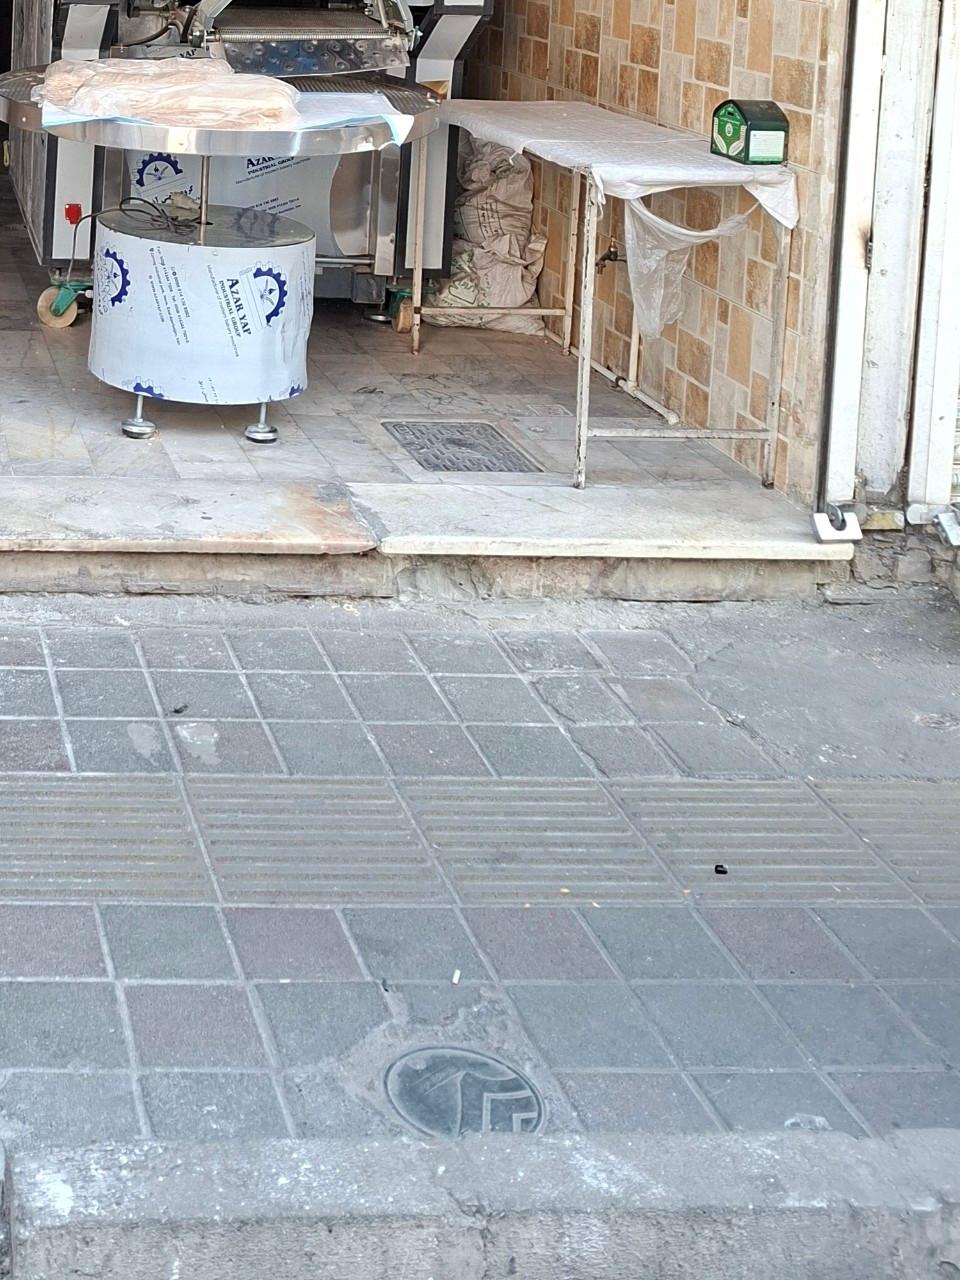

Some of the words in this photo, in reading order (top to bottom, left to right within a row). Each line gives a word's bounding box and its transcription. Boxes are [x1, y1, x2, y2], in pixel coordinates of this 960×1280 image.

[219, 280, 234, 315] INDUSTRIAL
[231, 317, 241, 338] GROUP
[227, 276, 247, 312] AZAR
[238, 314, 251, 336] YAP
